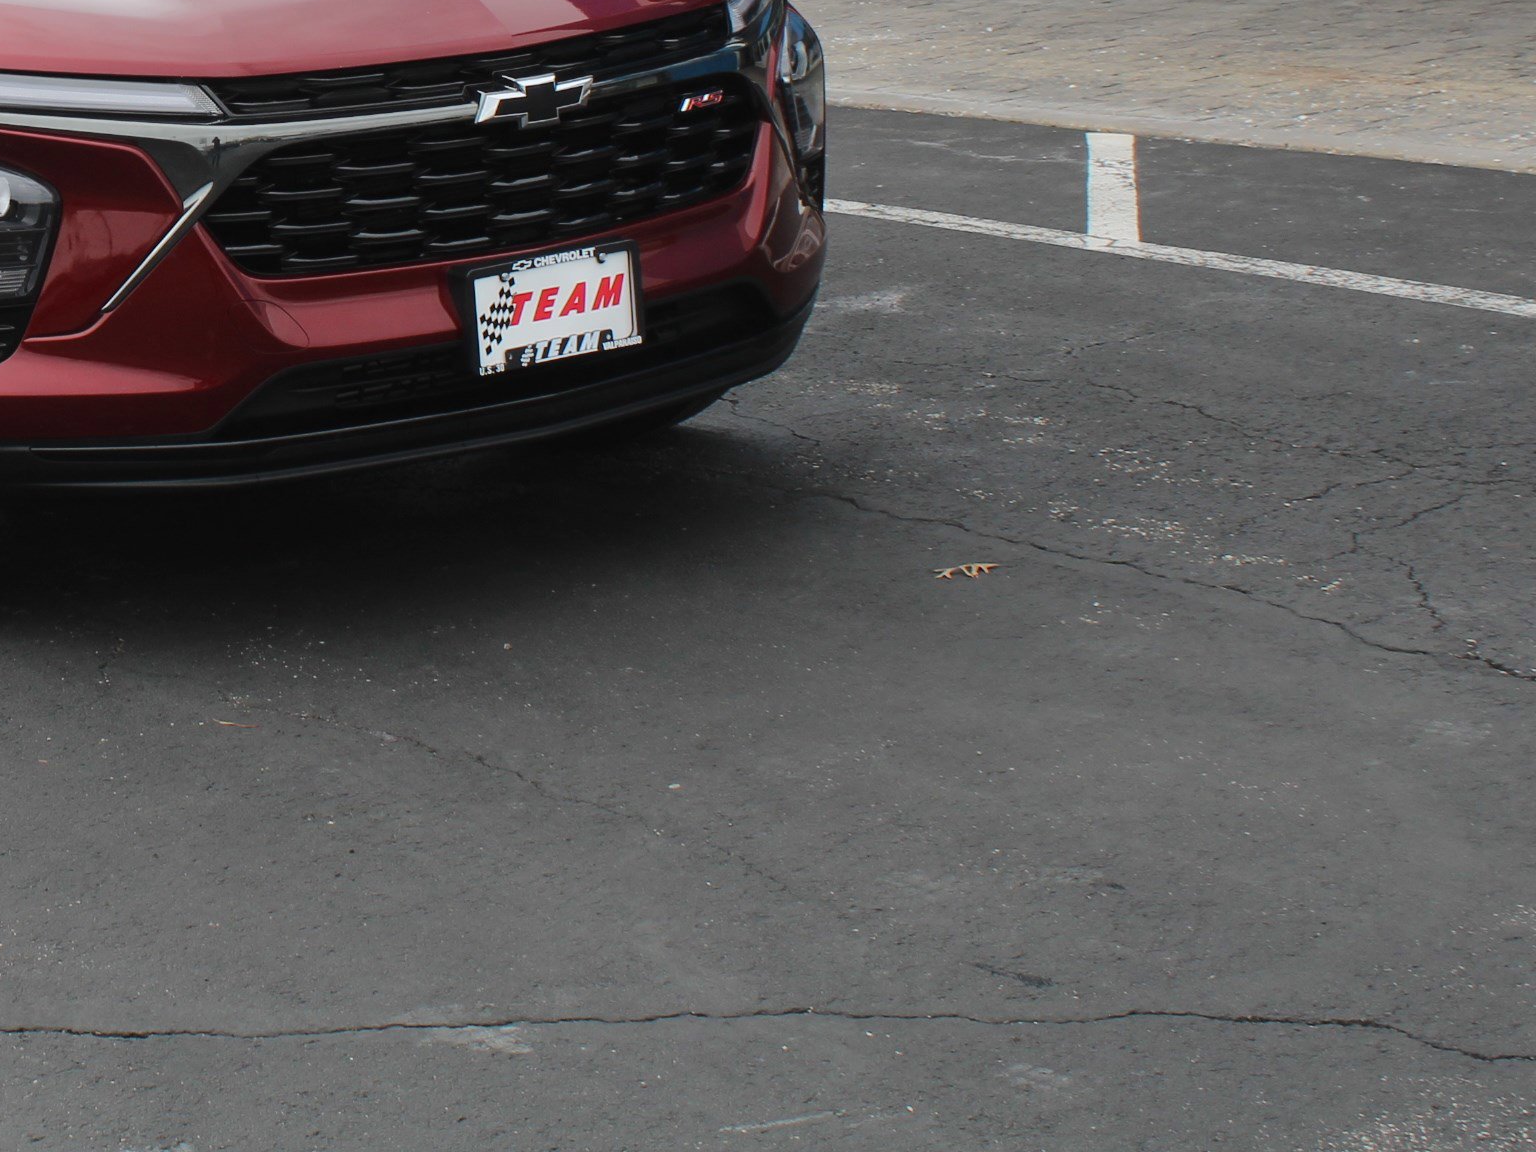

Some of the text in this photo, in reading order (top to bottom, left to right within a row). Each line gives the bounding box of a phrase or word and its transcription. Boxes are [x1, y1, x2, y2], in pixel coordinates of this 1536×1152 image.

[680, 90, 724, 112] RS
[533, 247, 596, 268] CHEVROLET
[510, 273, 624, 326] TEAM
[534, 330, 600, 362] TEAM
[602, 335, 643, 351] VALPARAISO
